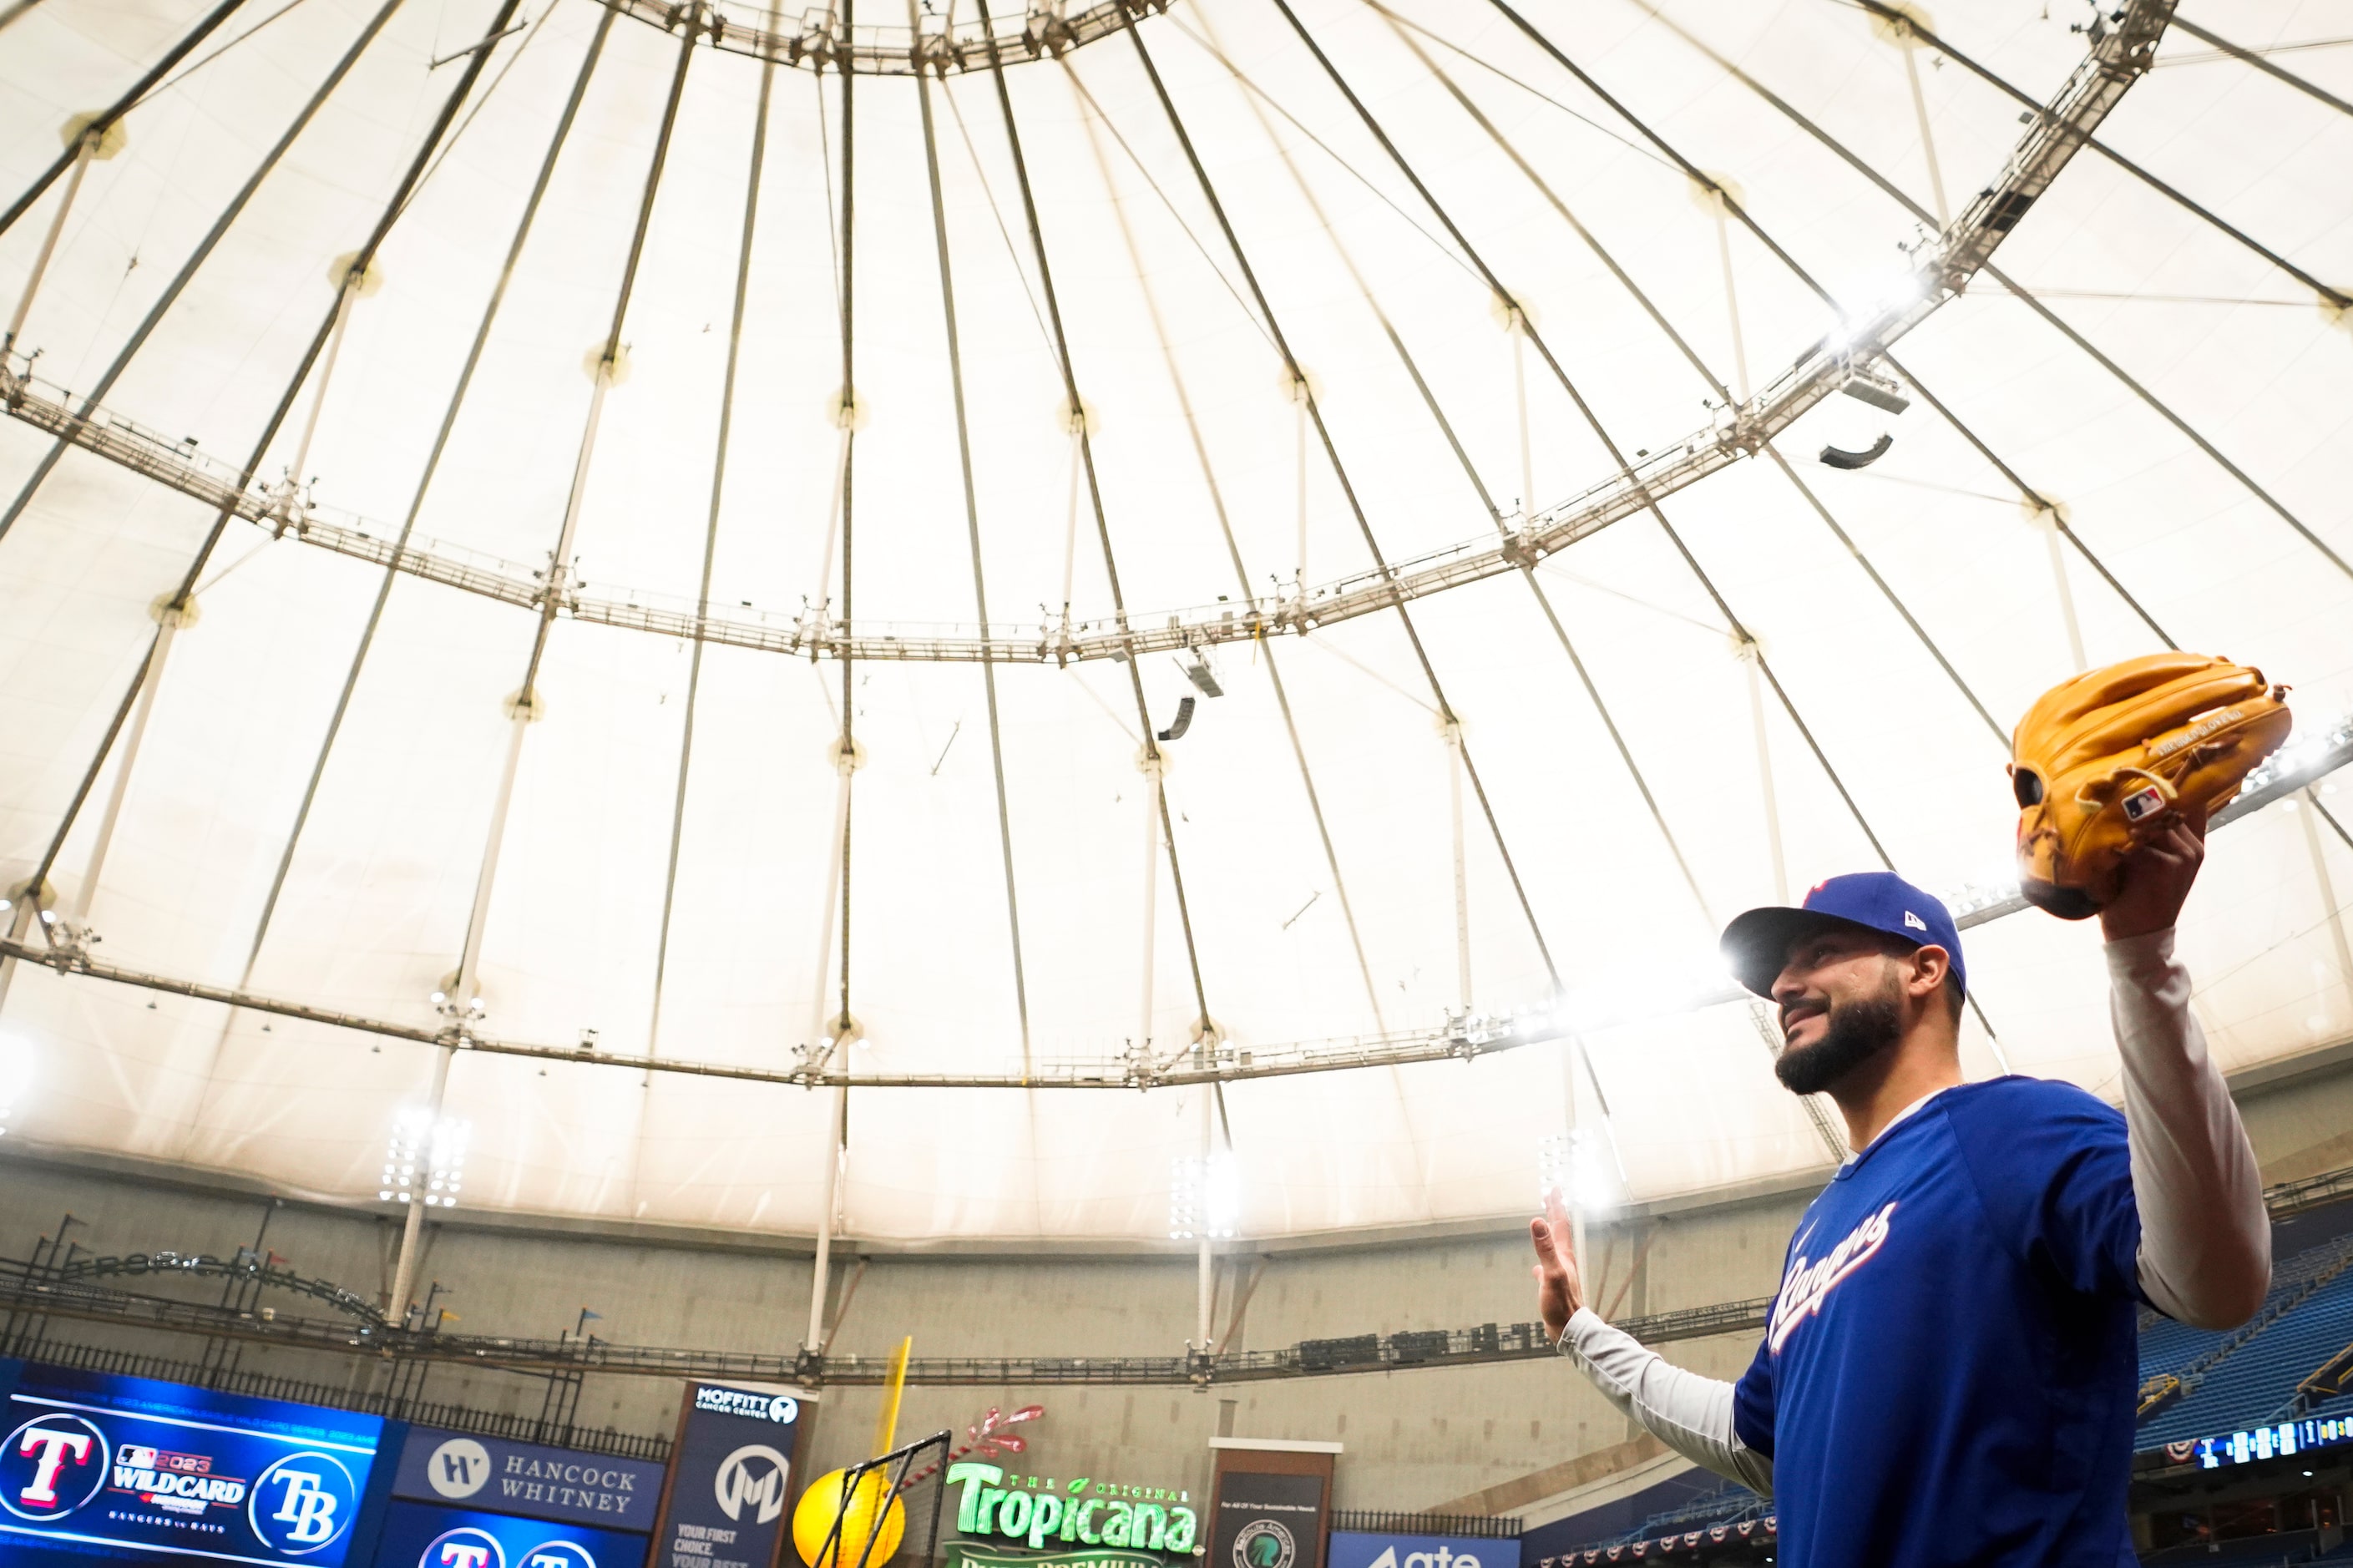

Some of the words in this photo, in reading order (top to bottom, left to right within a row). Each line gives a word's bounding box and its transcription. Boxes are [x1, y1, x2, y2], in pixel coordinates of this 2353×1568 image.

[695, 1400, 731, 1414] CANCER
[732, 1407, 767, 1419] CENTER
[697, 1387, 770, 1411] MOFFITT
[20, 1427, 93, 1509] T
[156, 1455, 211, 1474] 2023
[504, 1455, 637, 1492] HANCOCK
[501, 1478, 631, 1514] WHITNEY
[1010, 1474, 1055, 1490] THE
[1096, 1482, 1190, 1503] ORIGINAL
[271, 1468, 337, 1544] TB
[946, 1462, 1197, 1554] Tropicana
[108, 1510, 173, 1527] RANGERS
[190, 1521, 226, 1535] RAYS
[677, 1524, 706, 1540] YOUR
[706, 1527, 738, 1545] FIRST
[673, 1537, 715, 1556] CHOICE.
